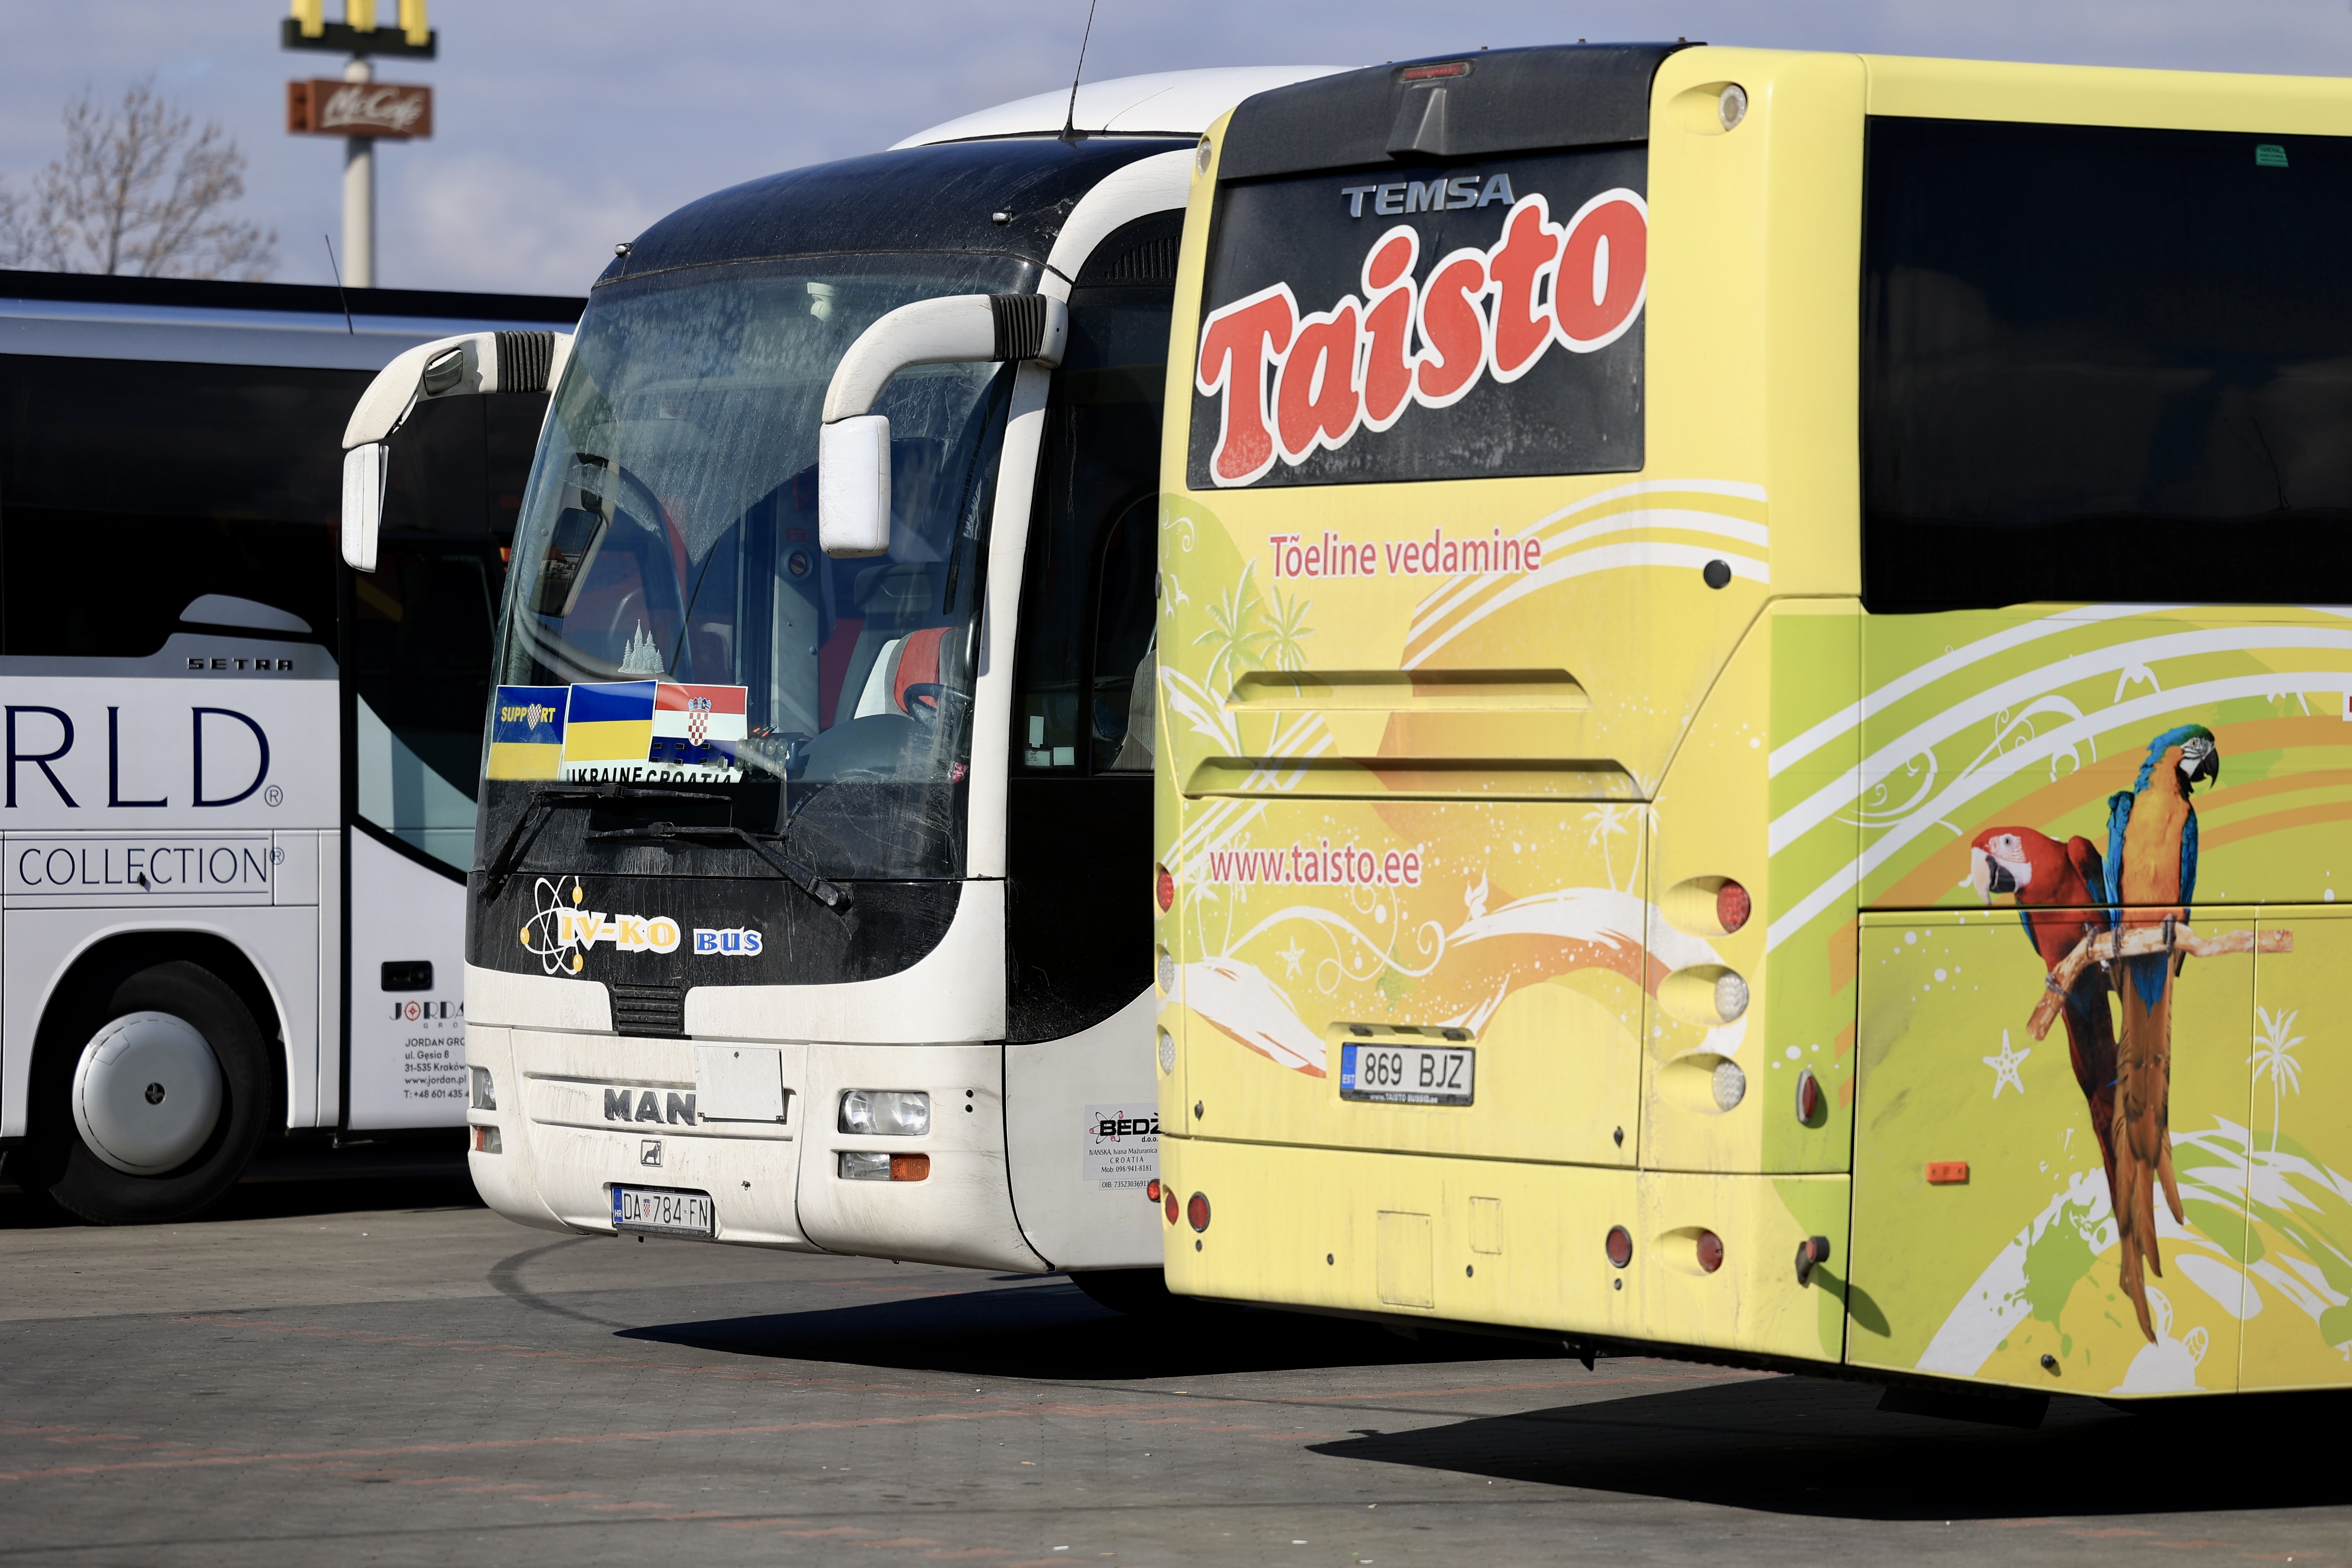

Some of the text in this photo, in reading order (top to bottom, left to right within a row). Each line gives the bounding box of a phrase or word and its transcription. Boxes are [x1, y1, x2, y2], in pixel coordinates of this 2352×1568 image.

[1341, 173, 1515, 217] TEMSA
[1196, 188, 1648, 487] Taisto
[1270, 529, 1541, 577] Tõeline vedamine
[187, 658, 293, 671] SETRA
[567, 766, 643, 782] UKRAINE
[646, 769, 732, 783] CROATIA
[1210, 839, 1421, 884] www.taisto.ee
[560, 912, 761, 954] IV-KO BUS
[405, 1038, 444, 1047] JORDAN
[405, 1050, 449, 1061] ul. Gęsia 8
[405, 1062, 466, 1072] 31-535 Kraków
[1364, 1052, 1464, 1089] 869 BJZ
[405, 1075, 466, 1087] www.jordan.pl
[1343, 1074, 1355, 1084] EST
[604, 1088, 697, 1125] MAN
[615, 1209, 622, 1218] HR
[624, 1193, 642, 1220] DA
